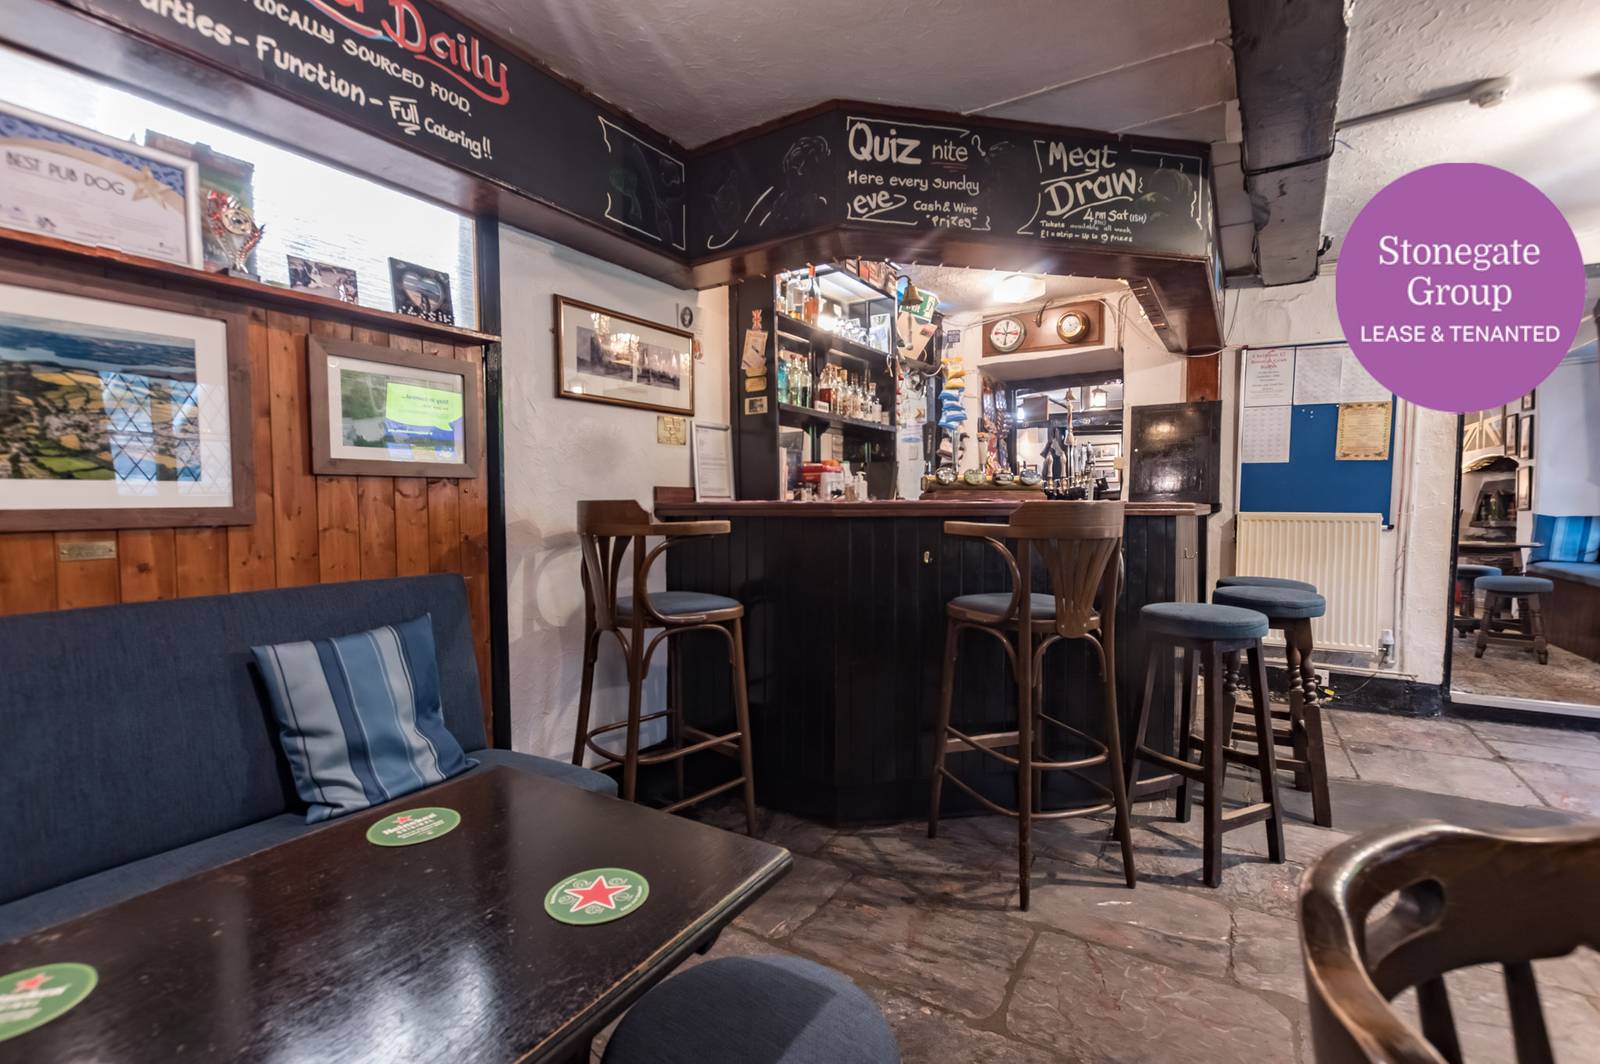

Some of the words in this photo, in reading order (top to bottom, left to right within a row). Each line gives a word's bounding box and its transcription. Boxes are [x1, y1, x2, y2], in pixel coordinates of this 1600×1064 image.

[341, 38, 425, 89] SOURCED
[379, 0, 510, 106] Daily
[388, 100, 420, 124] Full
[848, 122, 922, 165] Quiz
[931, 139, 969, 162] nite
[1048, 141, 1118, 173] Meat
[6, 151, 40, 171] BEST
[48, 163, 78, 183] PUB
[84, 173, 126, 197] DOG
[847, 169, 885, 185] Here
[889, 176, 929, 192] every
[853, 190, 894, 214] eve
[1044, 168, 1137, 216] Draw
[953, 202, 979, 215] Wine
[1107, 209, 1129, 222] Sat
